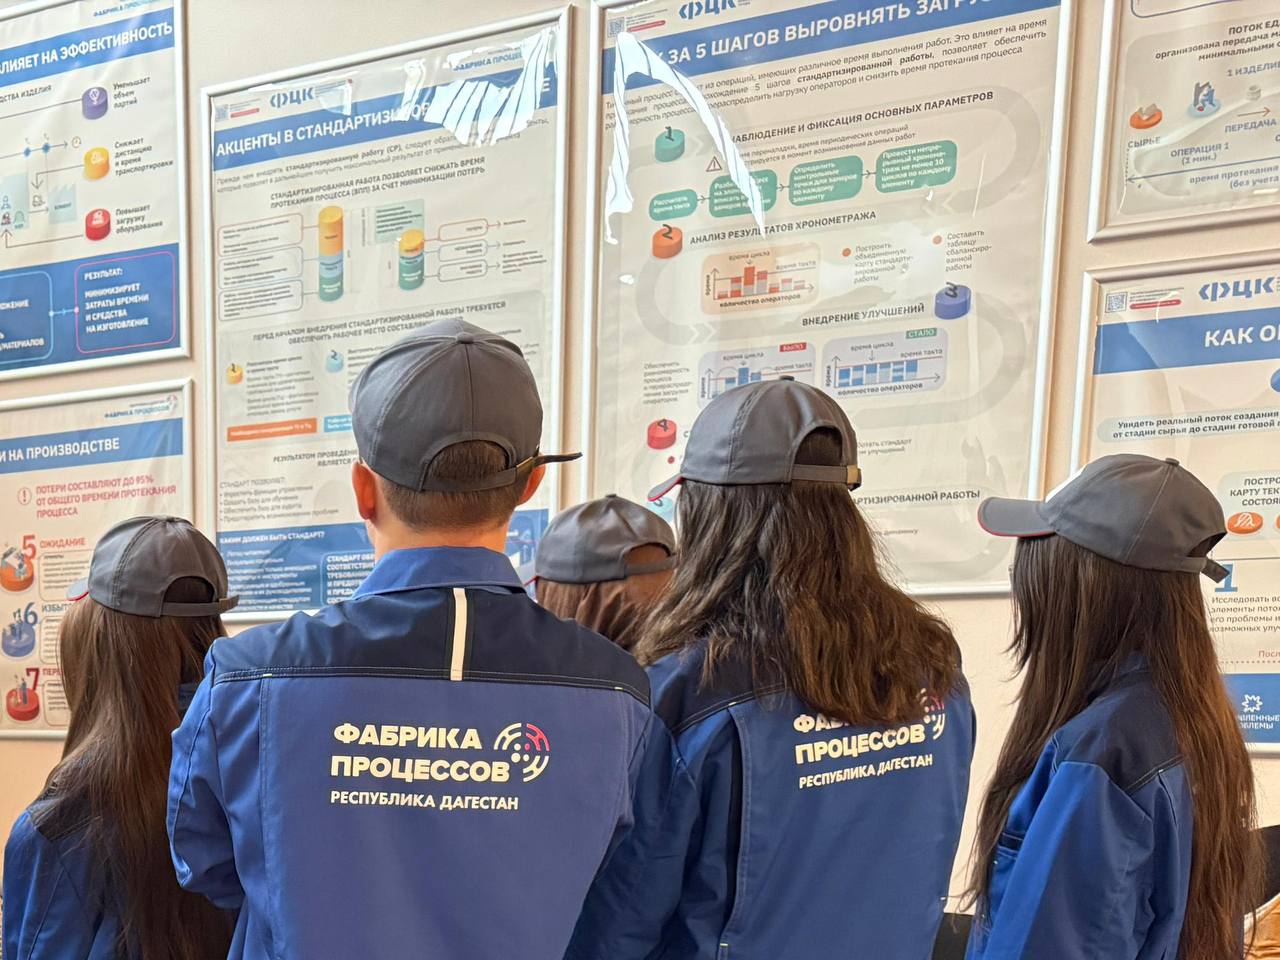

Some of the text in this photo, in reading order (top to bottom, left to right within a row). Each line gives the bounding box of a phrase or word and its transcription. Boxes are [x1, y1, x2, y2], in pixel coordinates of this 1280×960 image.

[668, 48, 691, 65] ЗА
[696, 43, 707, 59] 5
[711, 31, 779, 57] ШАГОВ
[784, 5, 910, 41] ВЫРОВНЯТЬ
[1228, 22, 1263, 36] ПОТОК
[42, 49, 58, 64] НА
[60, 21, 172, 60] ЭФФЕКТИВНОСТЬ
[1155, 34, 1269, 60] организована передача
[716, 18, 1047, 90] операций, имеющих различное время выполнения работ. Это влияет на время
[755, 31, 1047, 91] 5 шагов стандартизированной работы, позволяет обеспечить
[1198, 43, 1275, 62] минимальными
[773, 46, 1023, 99] нагрузку операторов и снизить время протекания процесса
[21, 85, 52, 99] ИЗДЕЛИЯ
[270, 87, 315, 108] ФЦК
[807, 114, 862, 132] ФИКСАЦИЯ
[864, 104, 921, 121] ОСНОВНЫХ
[924, 91, 994, 111] ПАРАМЕТРОВ
[874, 124, 909, 137] операций
[1225, 119, 1277, 133] ПЕРЕДАЧА
[114, 137, 144, 149] Снижает
[216, 130, 293, 157] АКЦЕНТЫ В
[895, 132, 915, 143] работ
[1170, 143, 1221, 158] ОПЕРАЦИЯ
[271, 156, 485, 200] СТАНДАРТИЗИРОВАННАЯ РАБОТА ПОЗВОЛЯЕТ СНИЖАТЬ ВРЕМЯ
[1189, 165, 1279, 184] время протекания
[1230, 175, 1280, 189] (без учета
[271, 196, 314, 209] ПРОТЕКАНИЯ
[315, 191, 351, 203] ПРОЦЕССА
[381, 181, 398, 191] СЧЕТ
[400, 172, 455, 187] МИНИМИЗАЦИИ
[457, 167, 485, 178] ПОТЕРЬ
[690, 232, 726, 245] АНАЛИЗ
[795, 211, 876, 229] ХРОНОМЕТРАЖА
[947, 230, 985, 240] Составить
[946, 245, 992, 256] сбалансиро-
[947, 239, 977, 250] таблицу
[945, 263, 972, 272] работы
[946, 255, 973, 264] ванной
[84, 268, 123, 281] РЕЗУЛЬТАТ:
[1198, 277, 1275, 302] ФЦК
[253, 301, 506, 341] ПЕРЕД НАЧАЛОМ ВНЕДРЕНИЯ СТАНДАРТИЗИРОВАННОЙ РАБОТЫ ТРЕБУЕТСЯ
[802, 302, 925, 327] ВНЕДРЕНИЕ УЛУЧШЕНИЙ
[288, 327, 385, 345] ОБЕСПЕЧИТЬ РАБОЧЕЕ МЕСТО
[908, 329, 934, 338] СТАЛО
[1204, 327, 1254, 347] КАК
[1118, 411, 1279, 429] Увидеть реальный поток создания
[1124, 428, 1156, 438] стадии
[1158, 427, 1187, 437] сырья
[1189, 425, 1201, 433] до
[1202, 423, 1236, 433] стадии
[1238, 421, 1275, 430] готовой
[9, 448, 24, 461] НА
[26, 438, 120, 459] ПРОИЗВОДСТВЕ
[36, 475, 154, 494] ПОТЕРИ СОСТАВЛЯЮТ ДО 95%
[1230, 489, 1260, 497] КАРТУ
[36, 486, 177, 507] ОТ ОБЩЕГО ВРЕМЕНИ ПРОТЕКАНИЯ
[940, 491, 980, 500] РАБОТЫ
[36, 508, 78, 519] ПРОЦЕССА
[22, 534, 37, 561] 5
[40, 538, 85, 548] ОЖИДАНИЕ
[1215, 563, 1238, 592] 1
[1212, 596, 1270, 604] Исследовать
[24, 602, 38, 626] 6
[1226, 615, 1273, 623] проблемы
[26, 668, 39, 691] 7
[334, 723, 482, 750] ФАБРИКА
[795, 723, 926, 764] ПРОЦЕССОВ
[331, 755, 510, 783] ПРОЦЕССОВ
[799, 754, 933, 789] РЕСПУБЛИКА ДАГЕСТАН
[331, 791, 519, 811] РЕСПУБЛИКА ДАГЕСТАН
